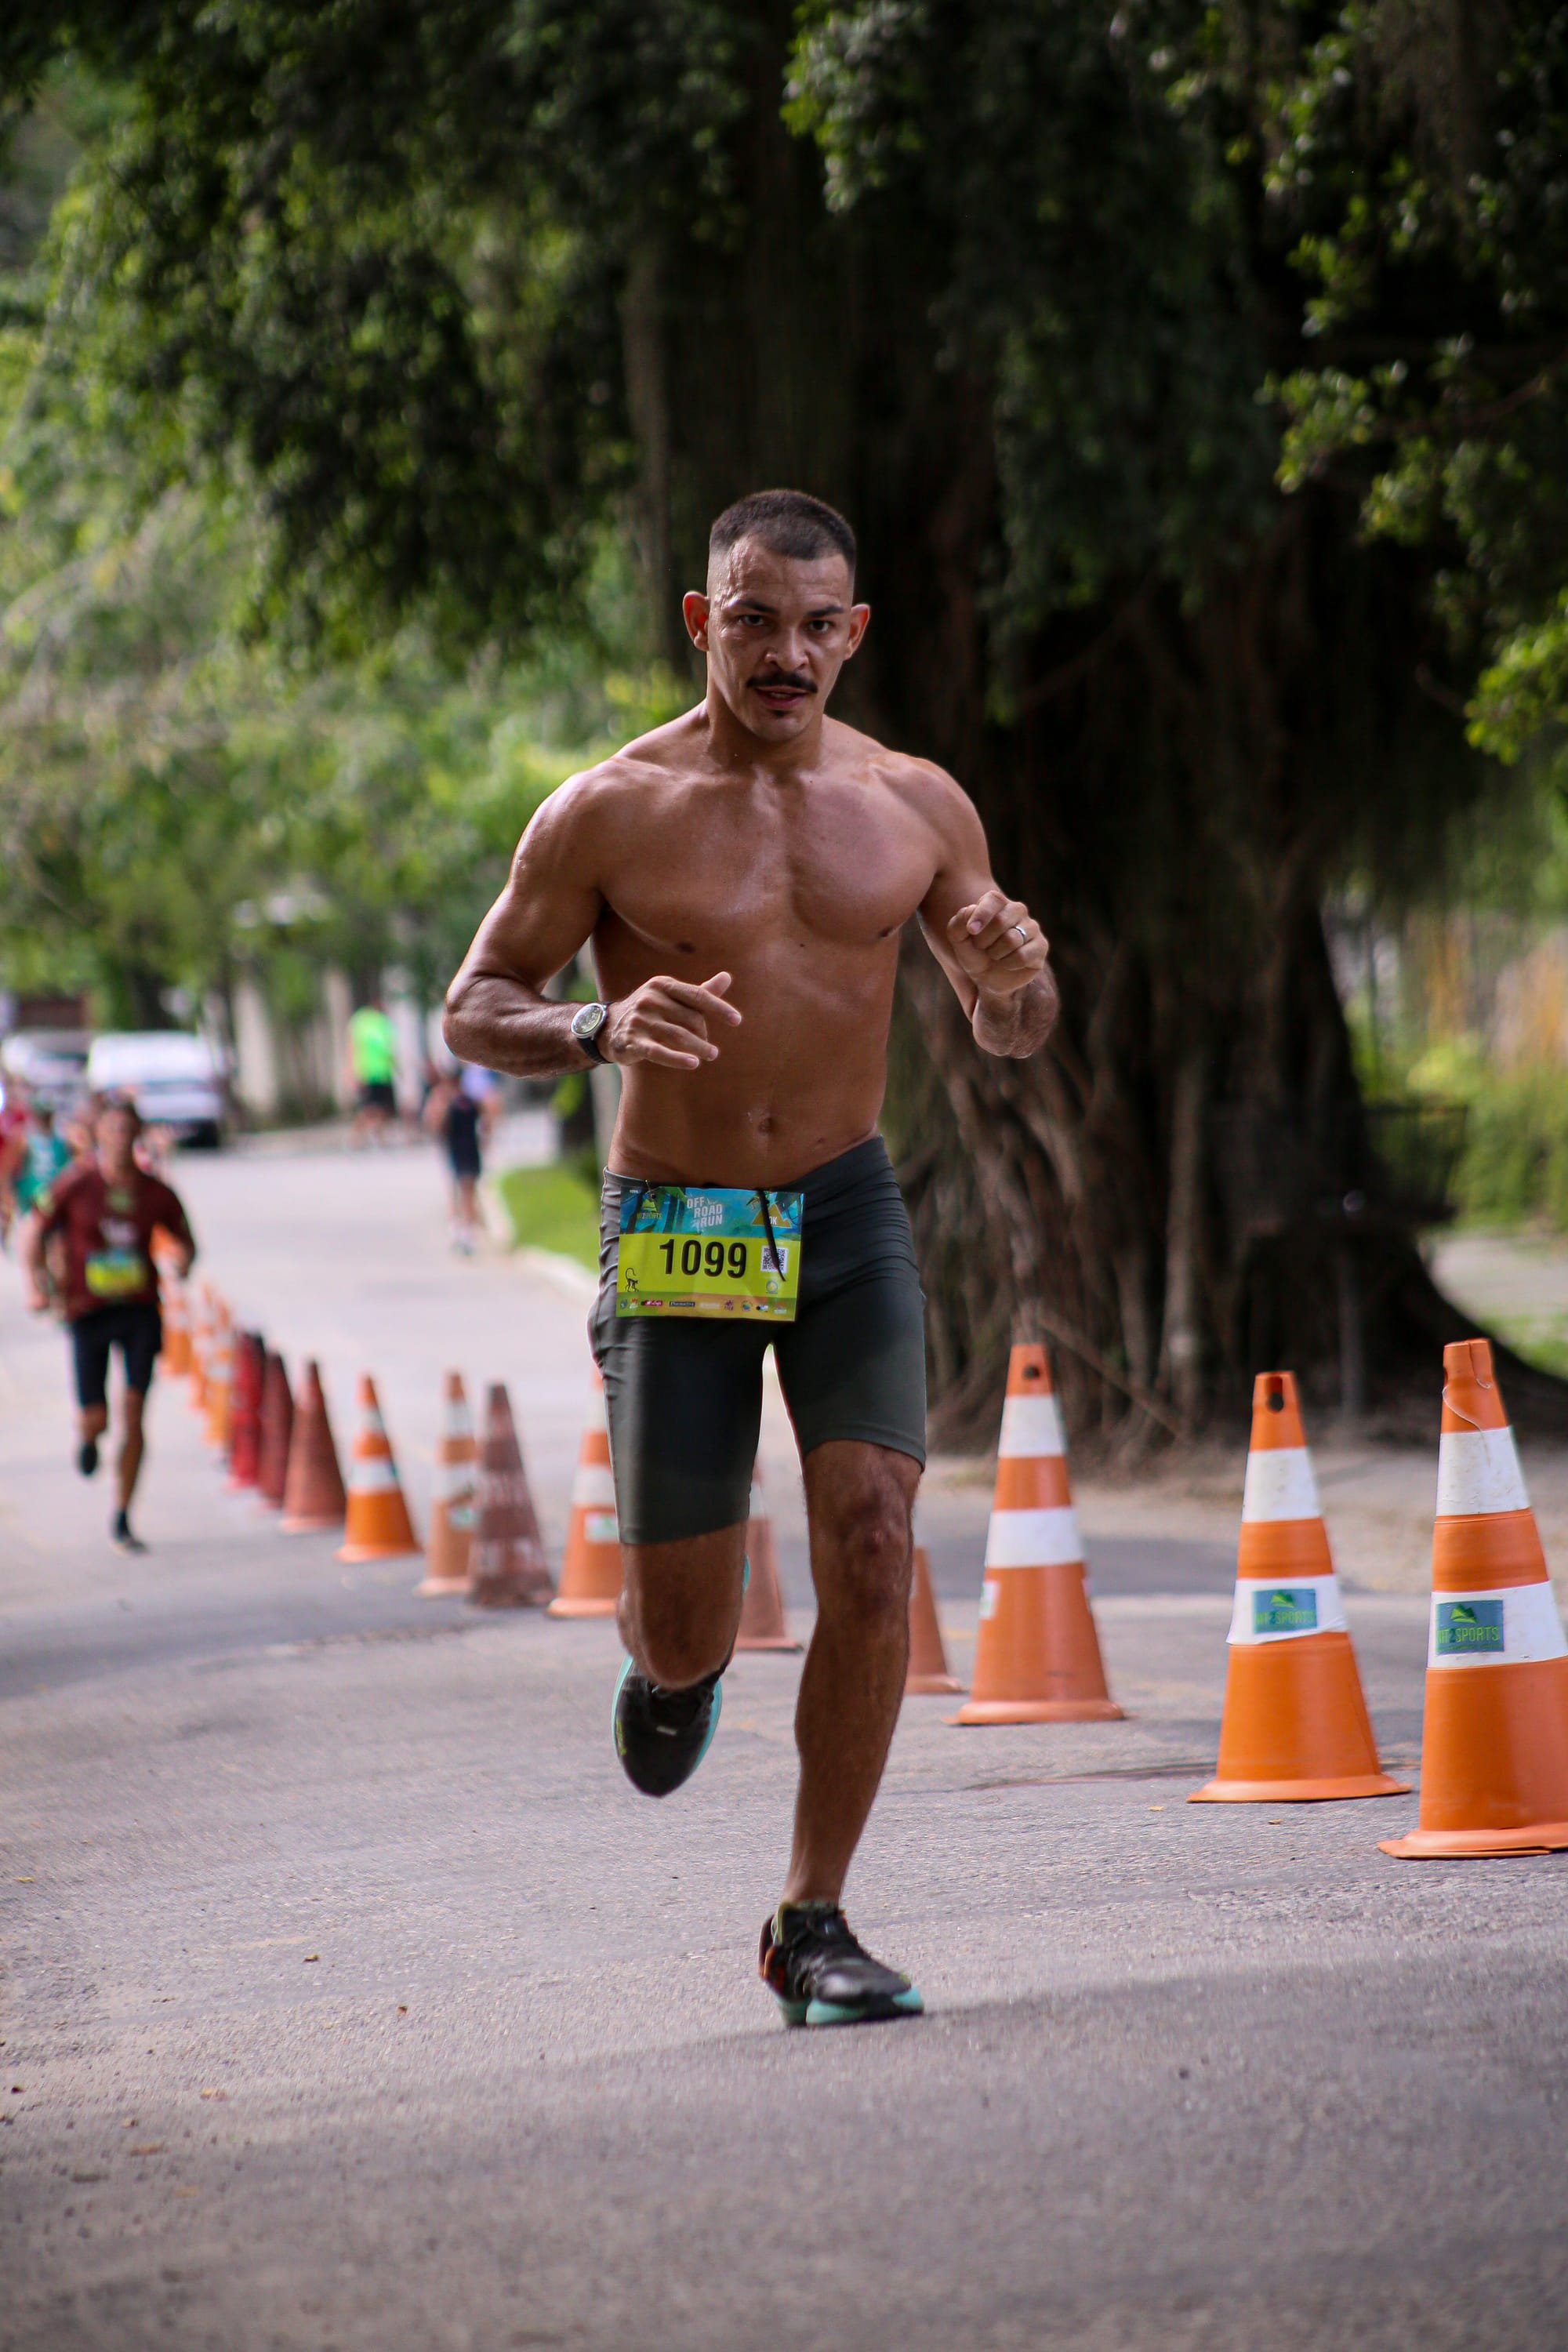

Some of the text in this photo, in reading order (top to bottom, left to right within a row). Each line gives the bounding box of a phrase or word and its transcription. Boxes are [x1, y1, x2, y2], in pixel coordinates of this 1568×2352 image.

[687, 1196, 705, 1209] OFF
[694, 1203, 723, 1218] ROAD
[700, 1214, 723, 1228] RUN
[659, 1239, 747, 1278] 1099
